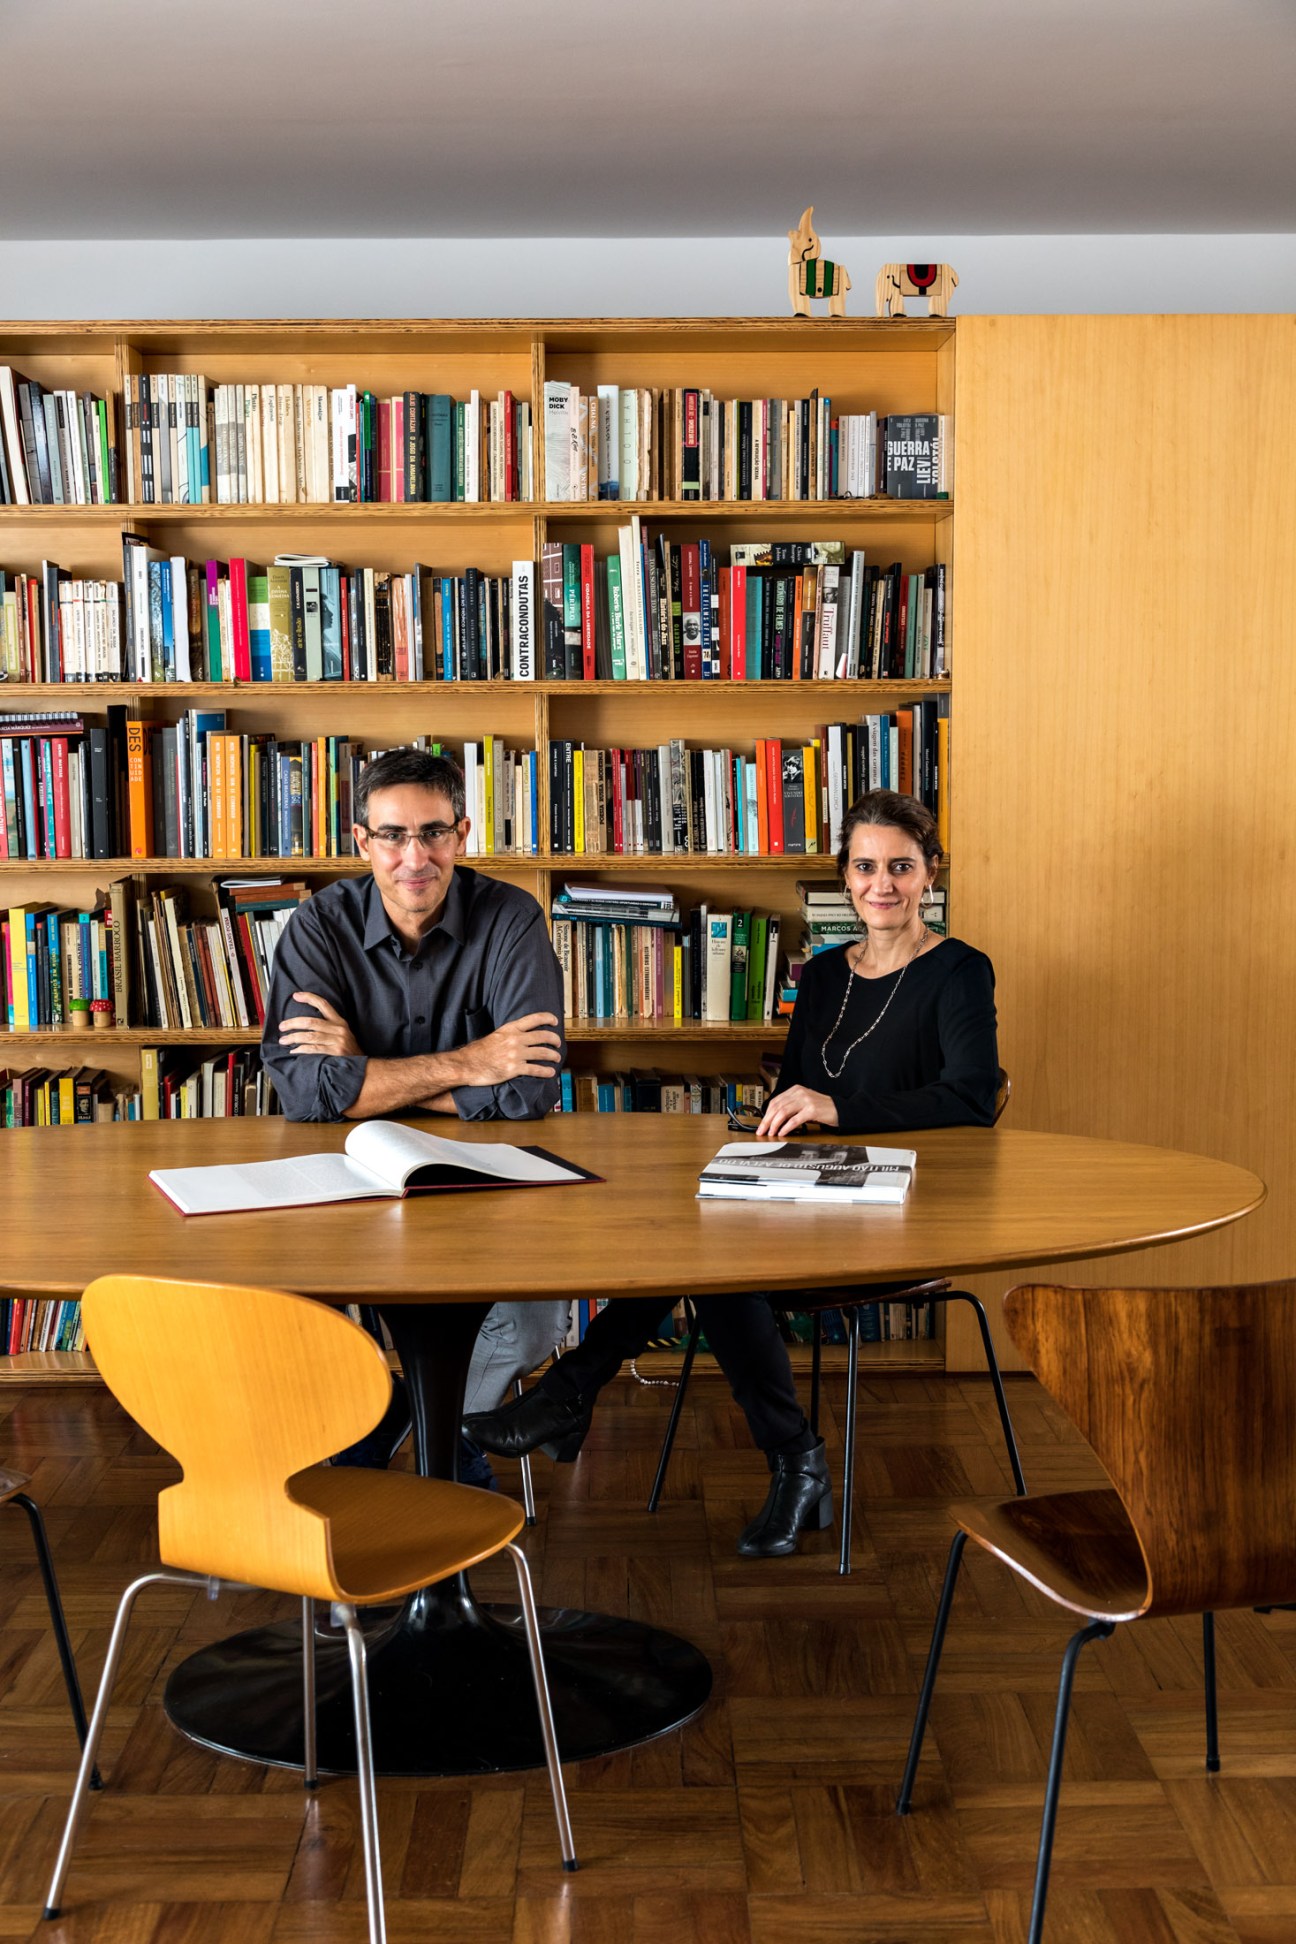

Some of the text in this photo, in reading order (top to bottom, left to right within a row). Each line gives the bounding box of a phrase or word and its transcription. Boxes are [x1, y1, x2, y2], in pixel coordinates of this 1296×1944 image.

[888, 441, 930, 455] GUERRA
[894, 457, 914, 471] PAZ
[917, 460, 931, 484] LIEV
[519, 576, 529, 677] CONTRACONDUTAS
[129, 727, 141, 752] DES
[821, 826, 850, 932] MARCOS
[113, 920, 121, 962] BARROCO
